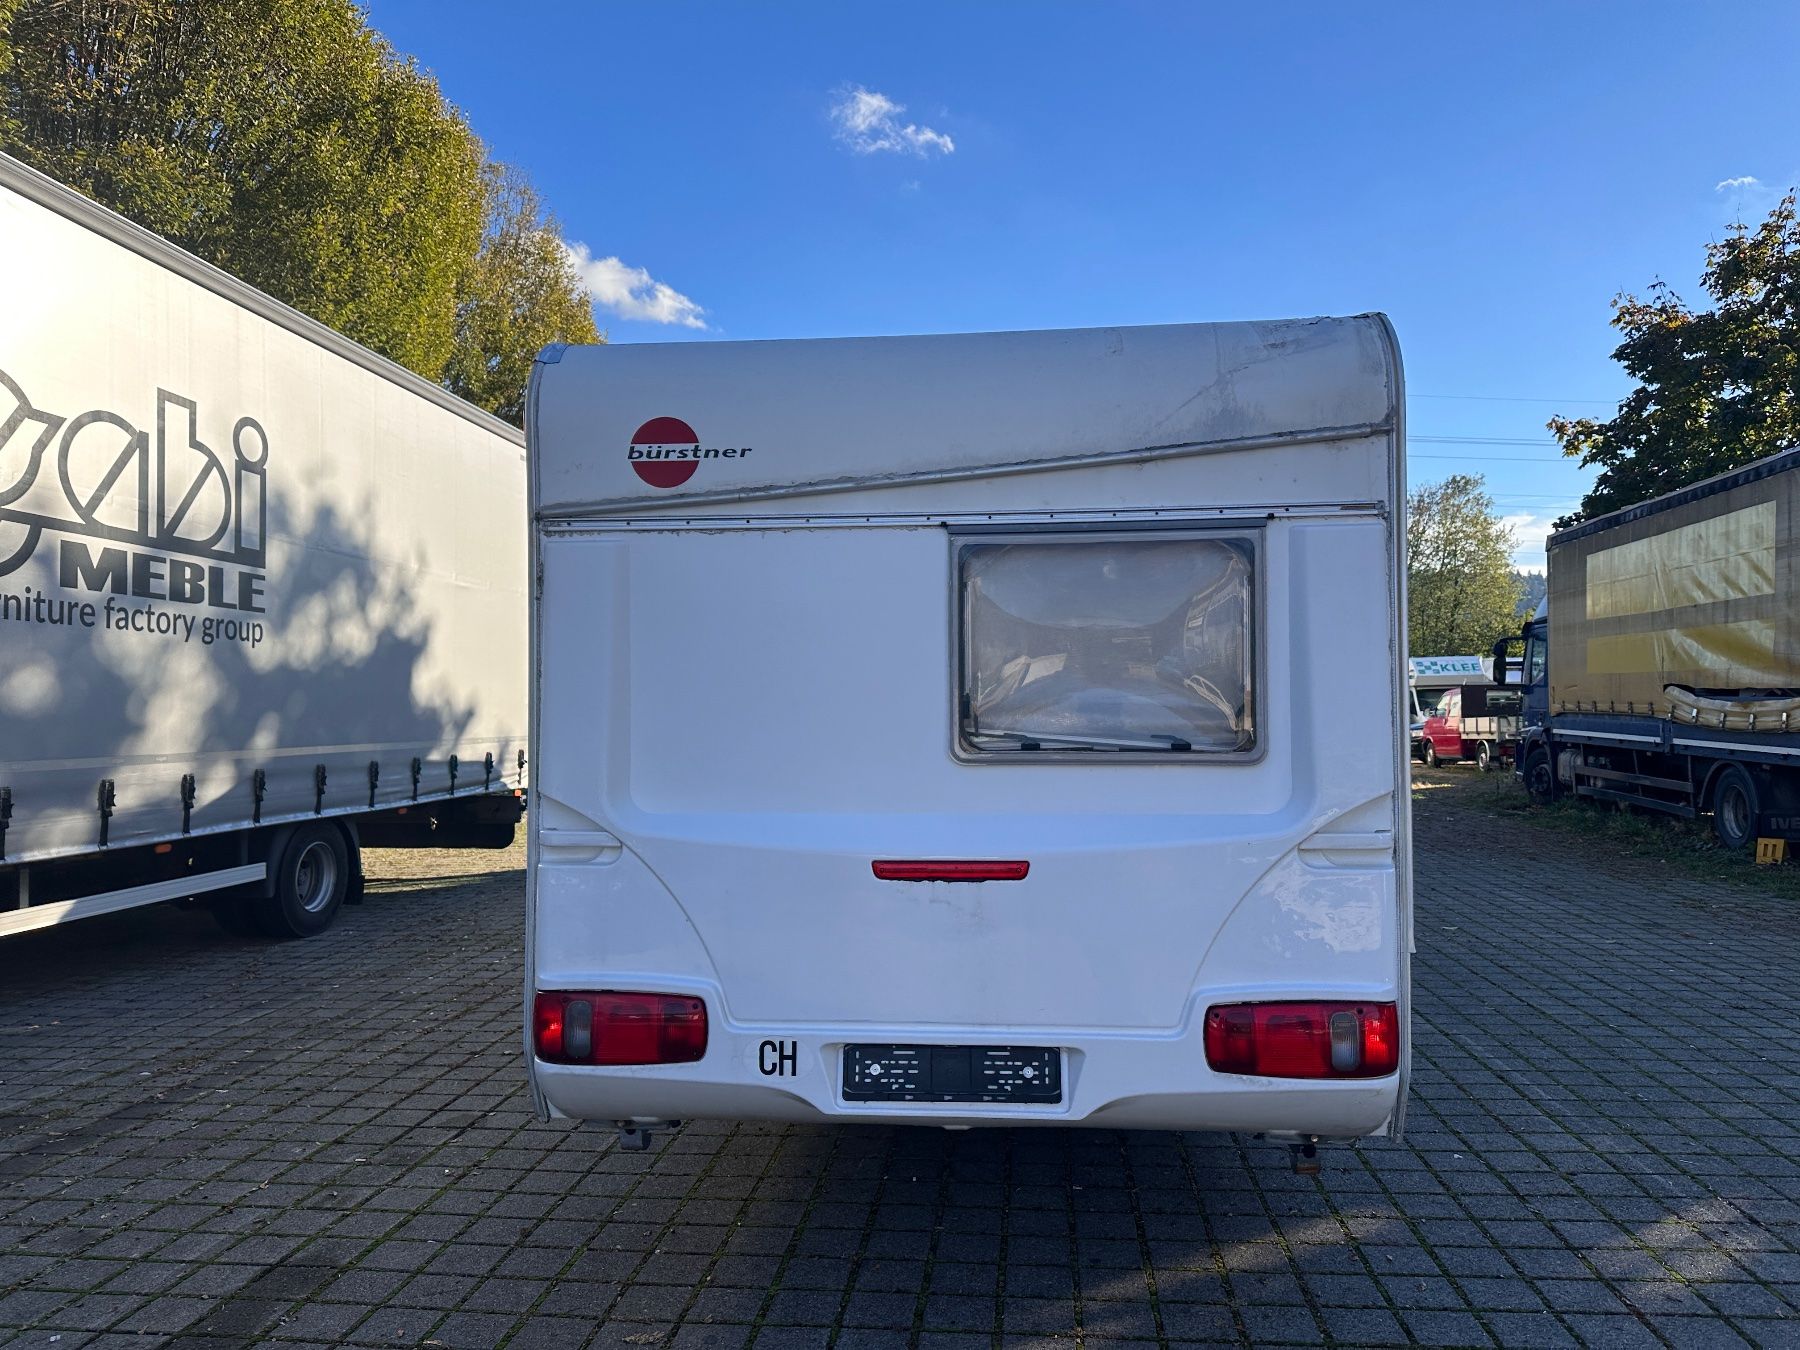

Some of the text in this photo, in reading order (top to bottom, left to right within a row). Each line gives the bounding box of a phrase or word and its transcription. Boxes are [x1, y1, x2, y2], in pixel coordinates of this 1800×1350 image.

[627, 444, 753, 460] bürstner
[59, 539, 266, 613] MEBLE
[0, 586, 264, 648] niture factory group
[1439, 662, 1481, 673] KLEE
[758, 1039, 798, 1077] CH
